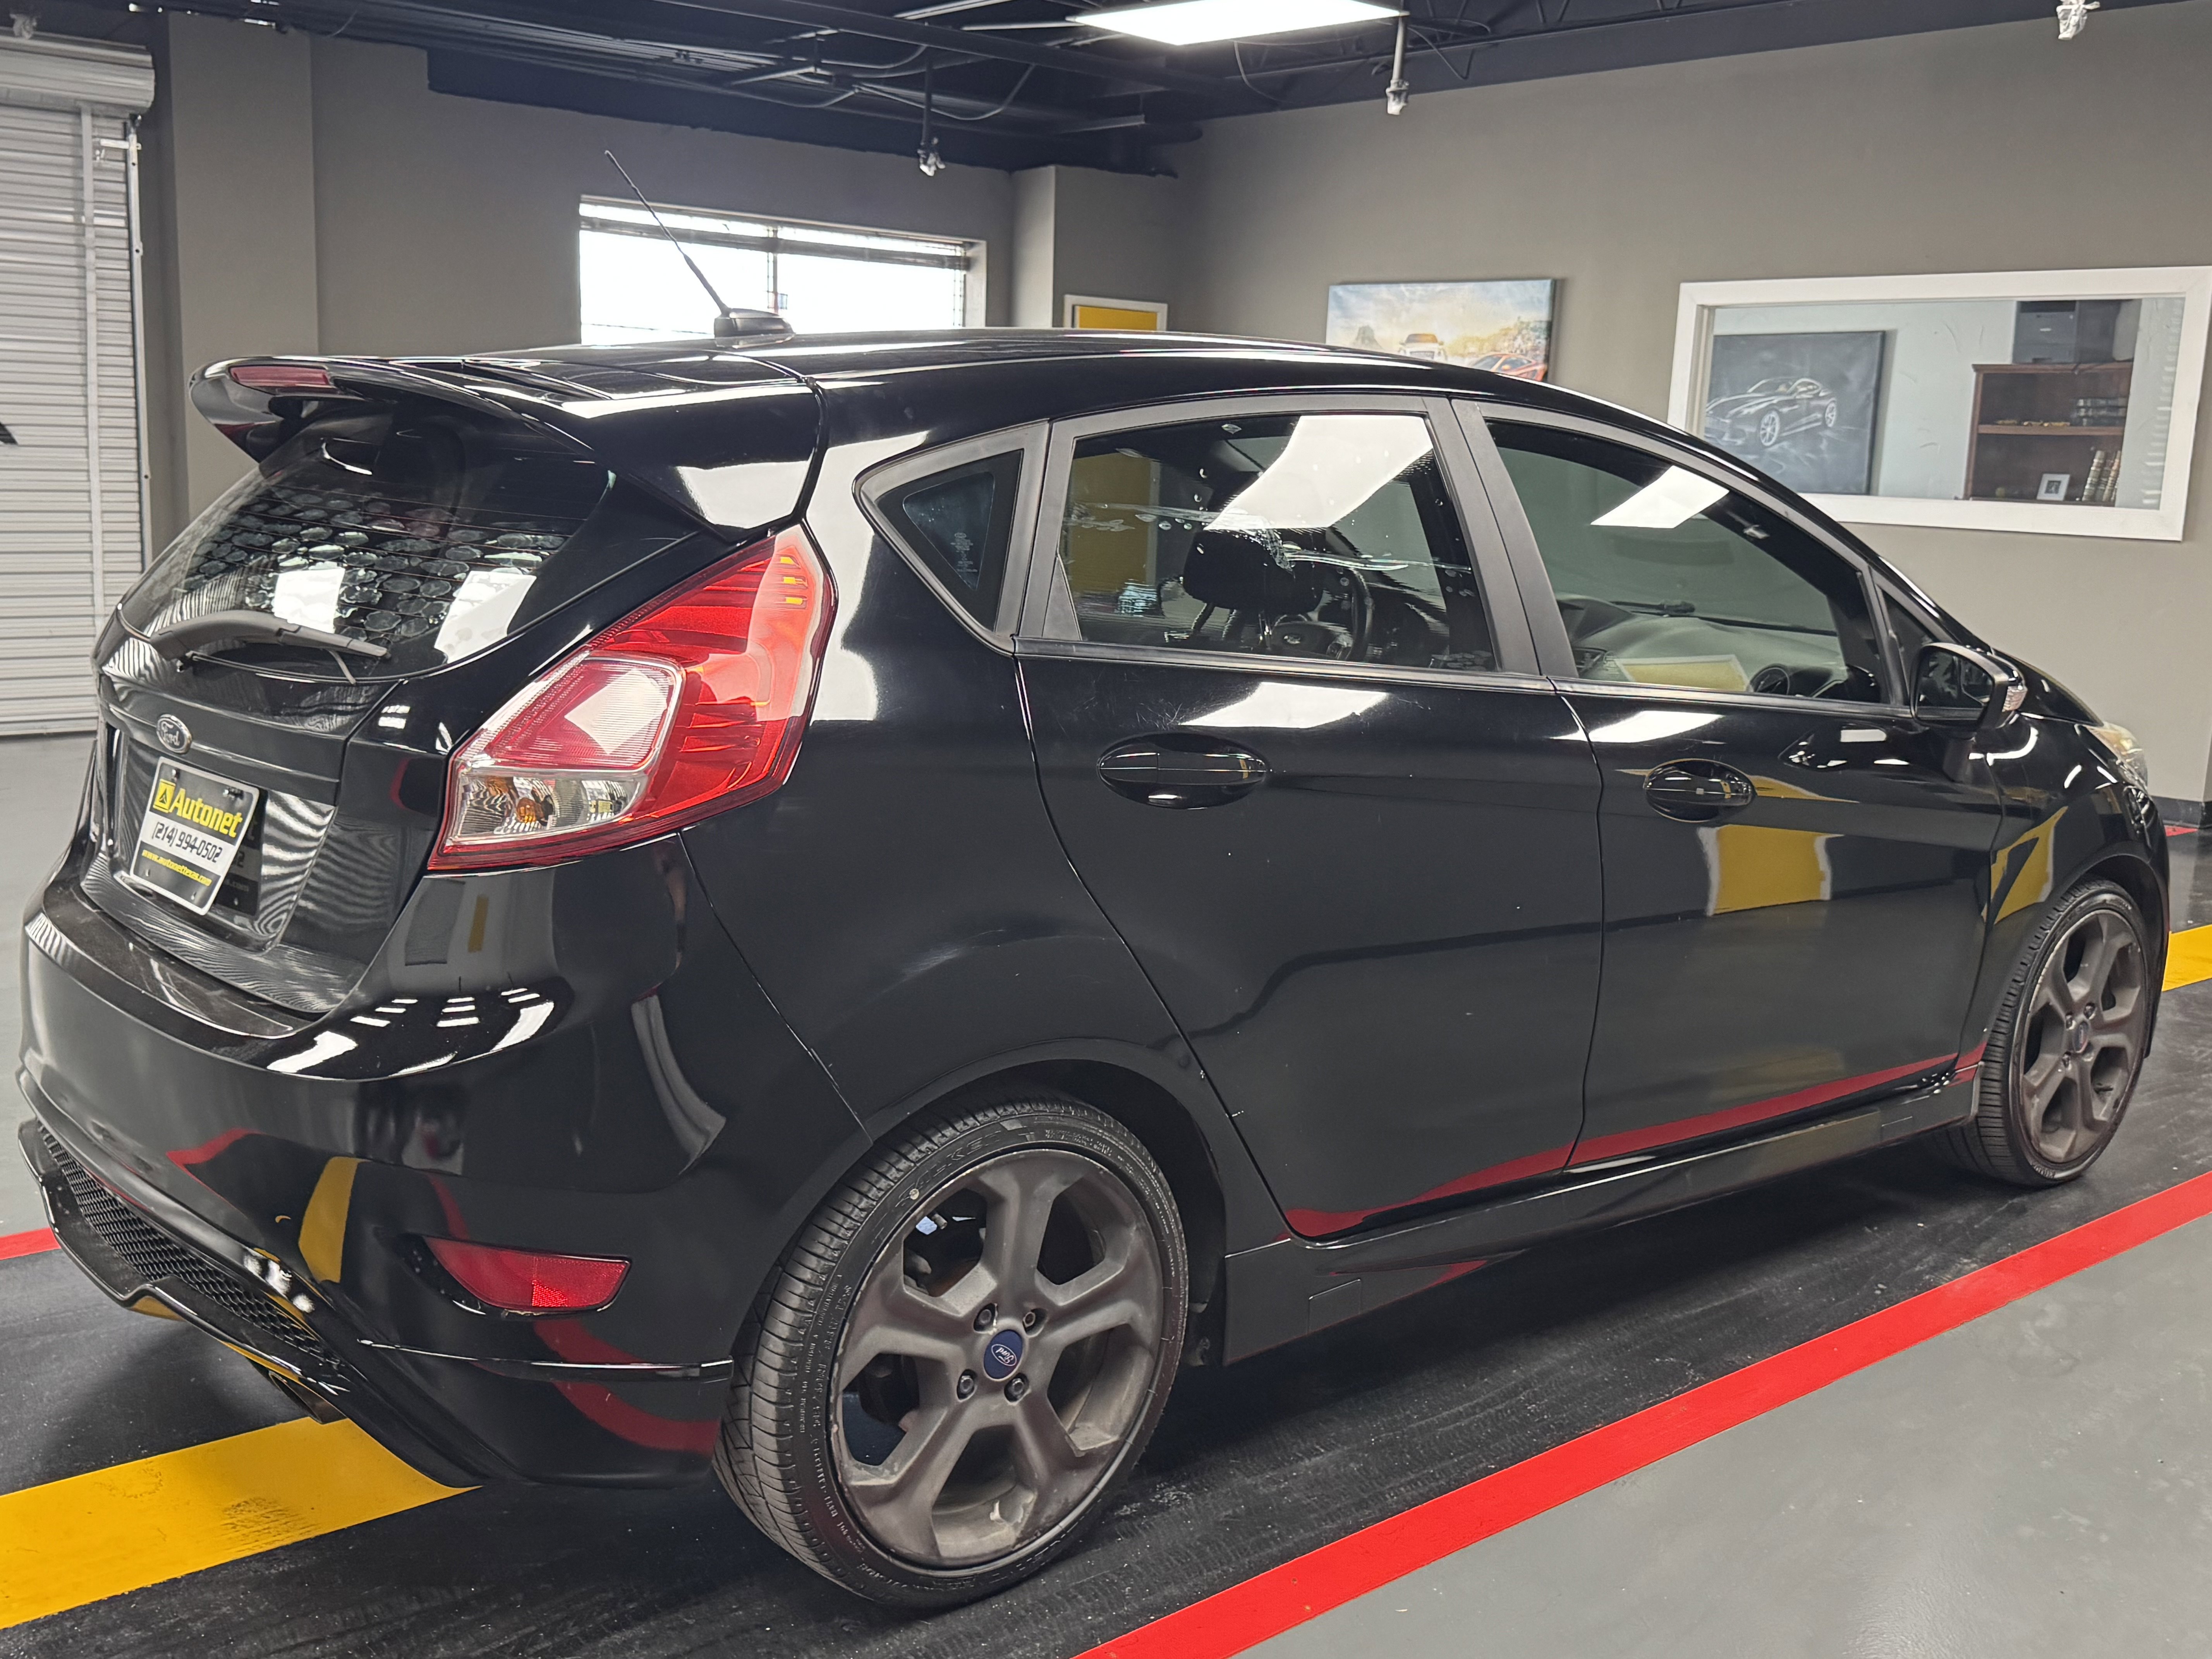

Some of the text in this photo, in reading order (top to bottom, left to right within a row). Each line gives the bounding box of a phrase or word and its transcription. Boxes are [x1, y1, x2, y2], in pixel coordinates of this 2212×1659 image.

[169, 788, 243, 838] Autonet
[152, 821, 178, 847] (214)
[176, 831, 223, 863] 994-0502
[995, 1347, 1014, 1364] Ford
